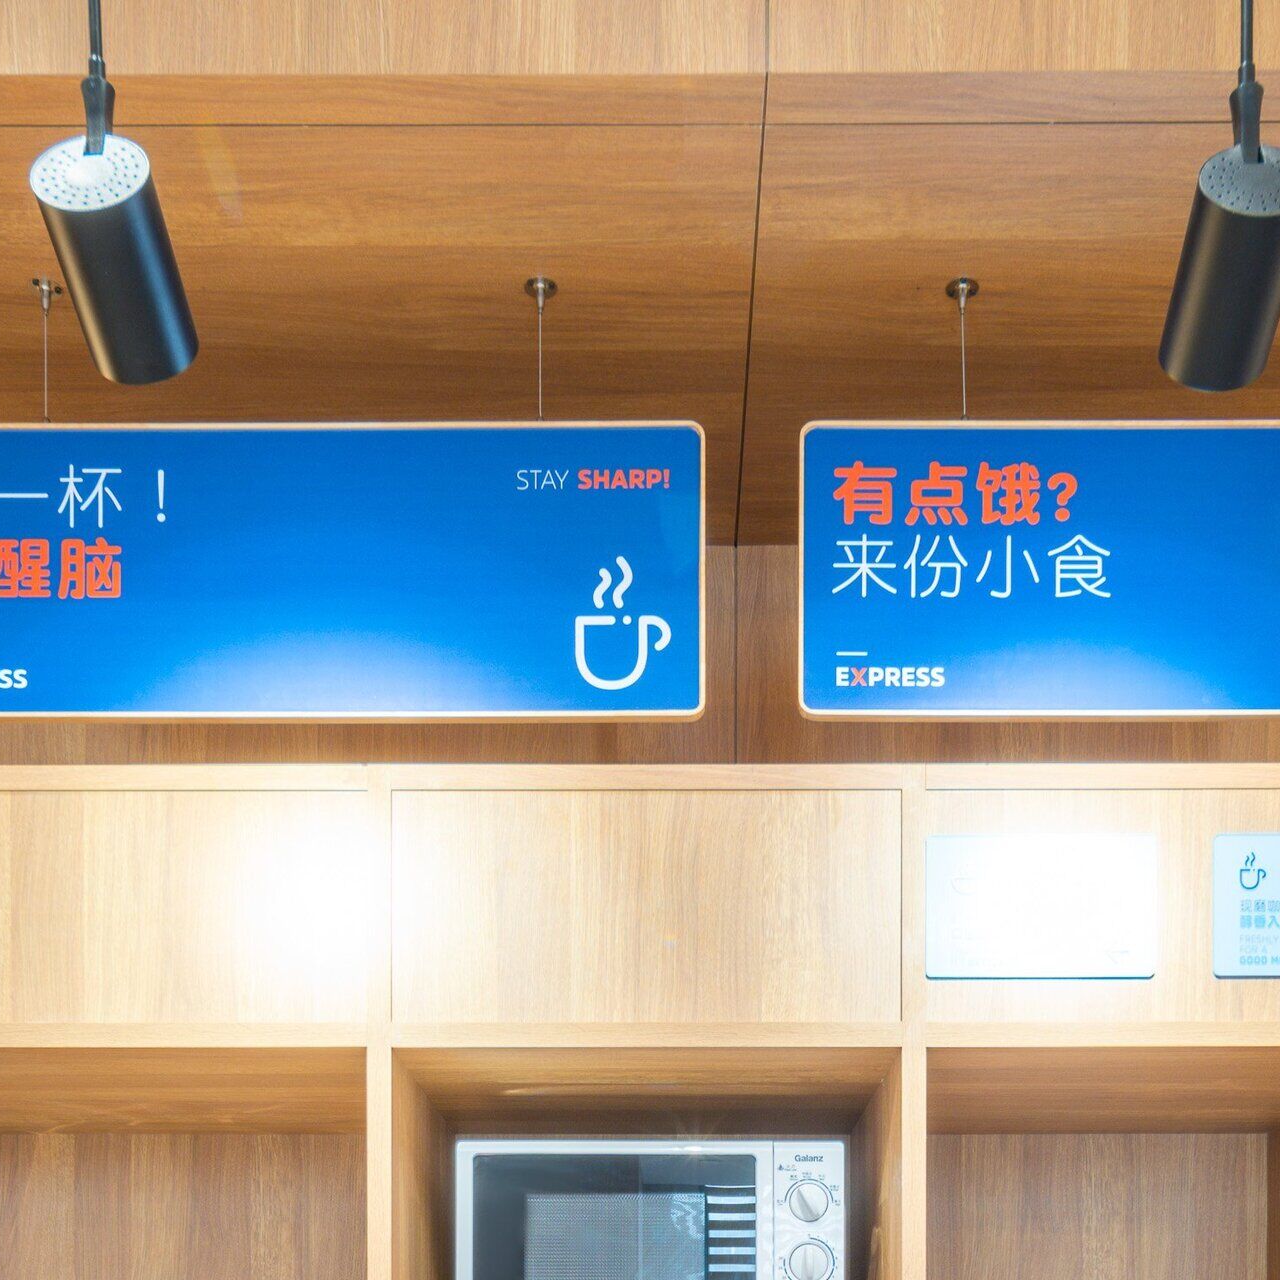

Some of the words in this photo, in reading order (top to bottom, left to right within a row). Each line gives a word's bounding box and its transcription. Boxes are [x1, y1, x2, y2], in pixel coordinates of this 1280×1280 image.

[516, 469, 569, 490] STAY
[577, 469, 671, 490] SHARP!
[832, 460, 1078, 526] 有点饿?
[832, 533, 1112, 600] 来份小食
[835, 667, 945, 688] EXPRESS
[1239, 935, 1280, 944] FRESHLY
[1239, 956, 1268, 966] GOOD
[794, 1154, 824, 1162] Galanz
